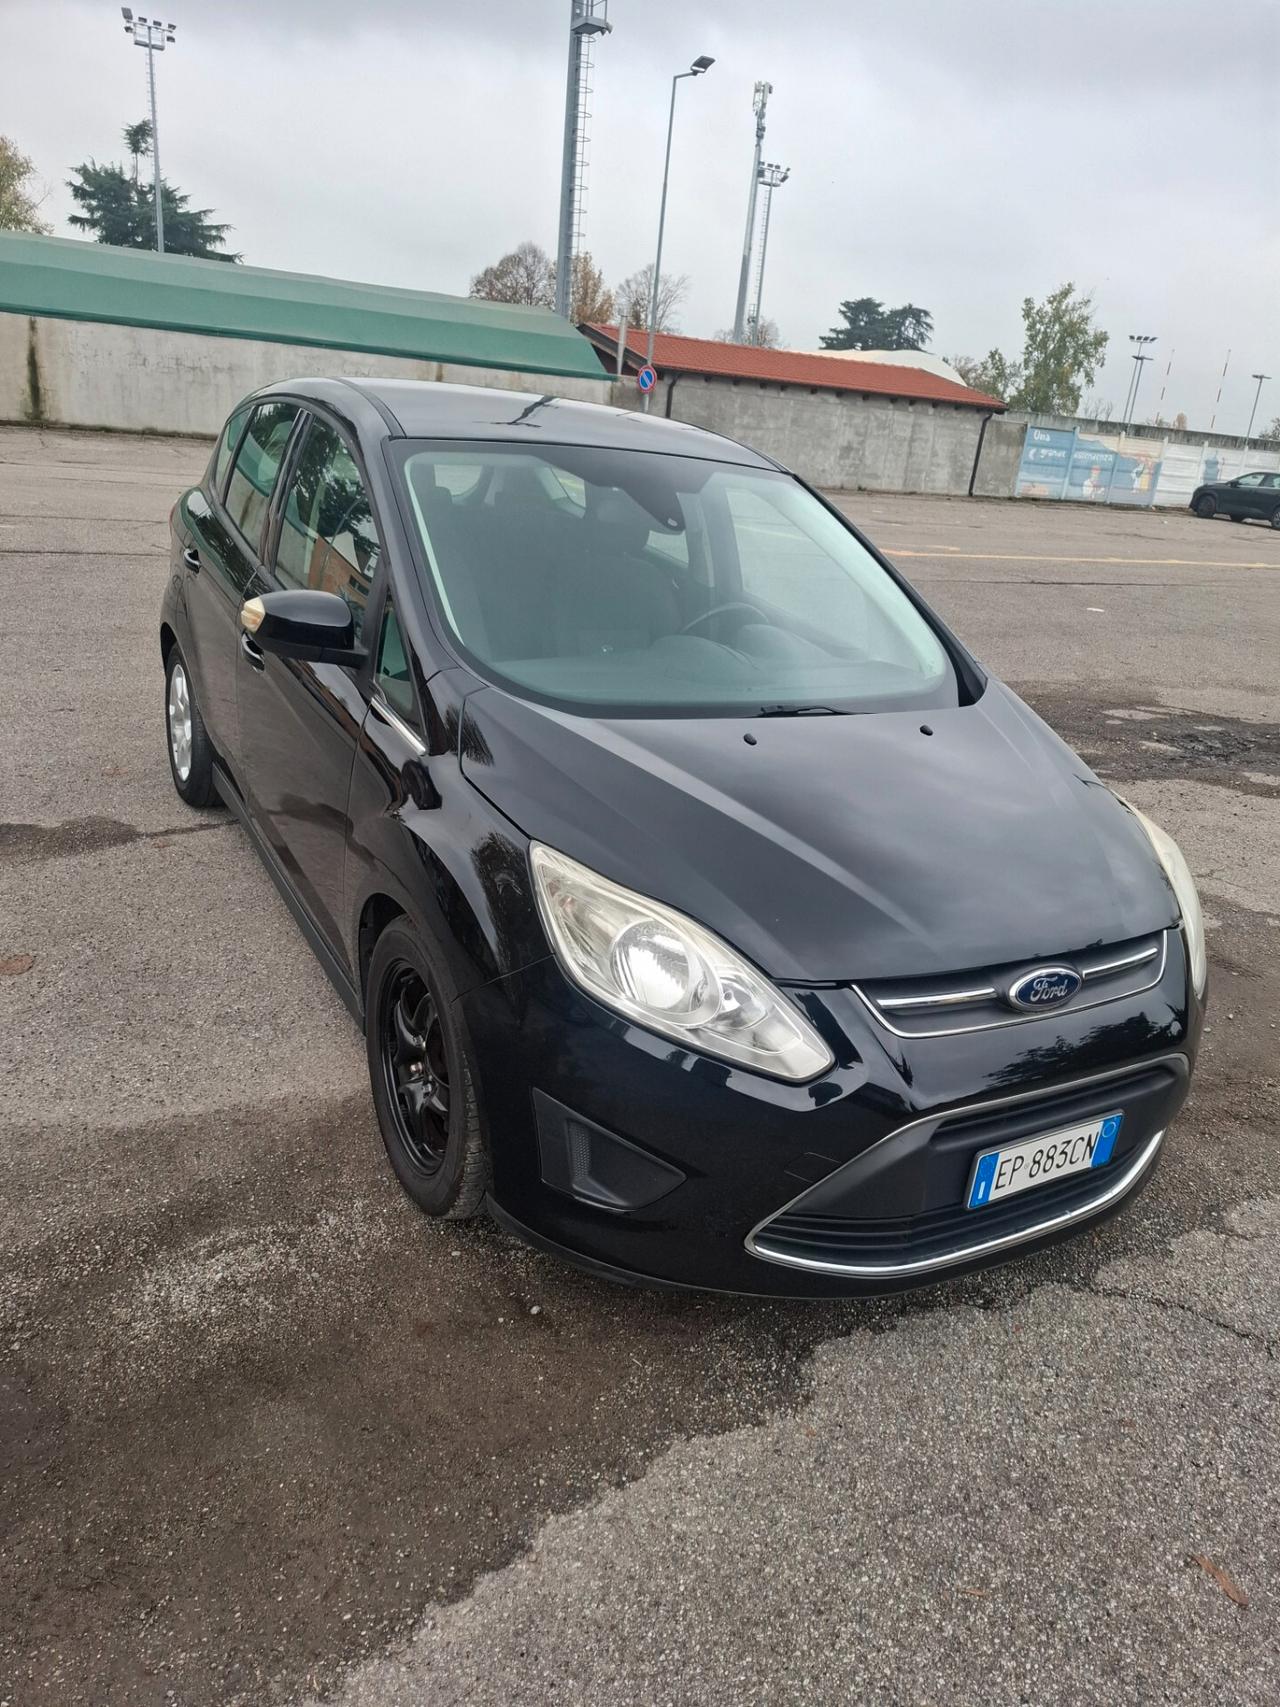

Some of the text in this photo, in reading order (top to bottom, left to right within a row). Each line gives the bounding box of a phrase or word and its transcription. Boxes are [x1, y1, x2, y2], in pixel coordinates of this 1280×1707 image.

[1030, 976, 1068, 1002] Ford
[994, 1155, 1025, 1191] EP
[1028, 1131, 1100, 1179] 883CN
